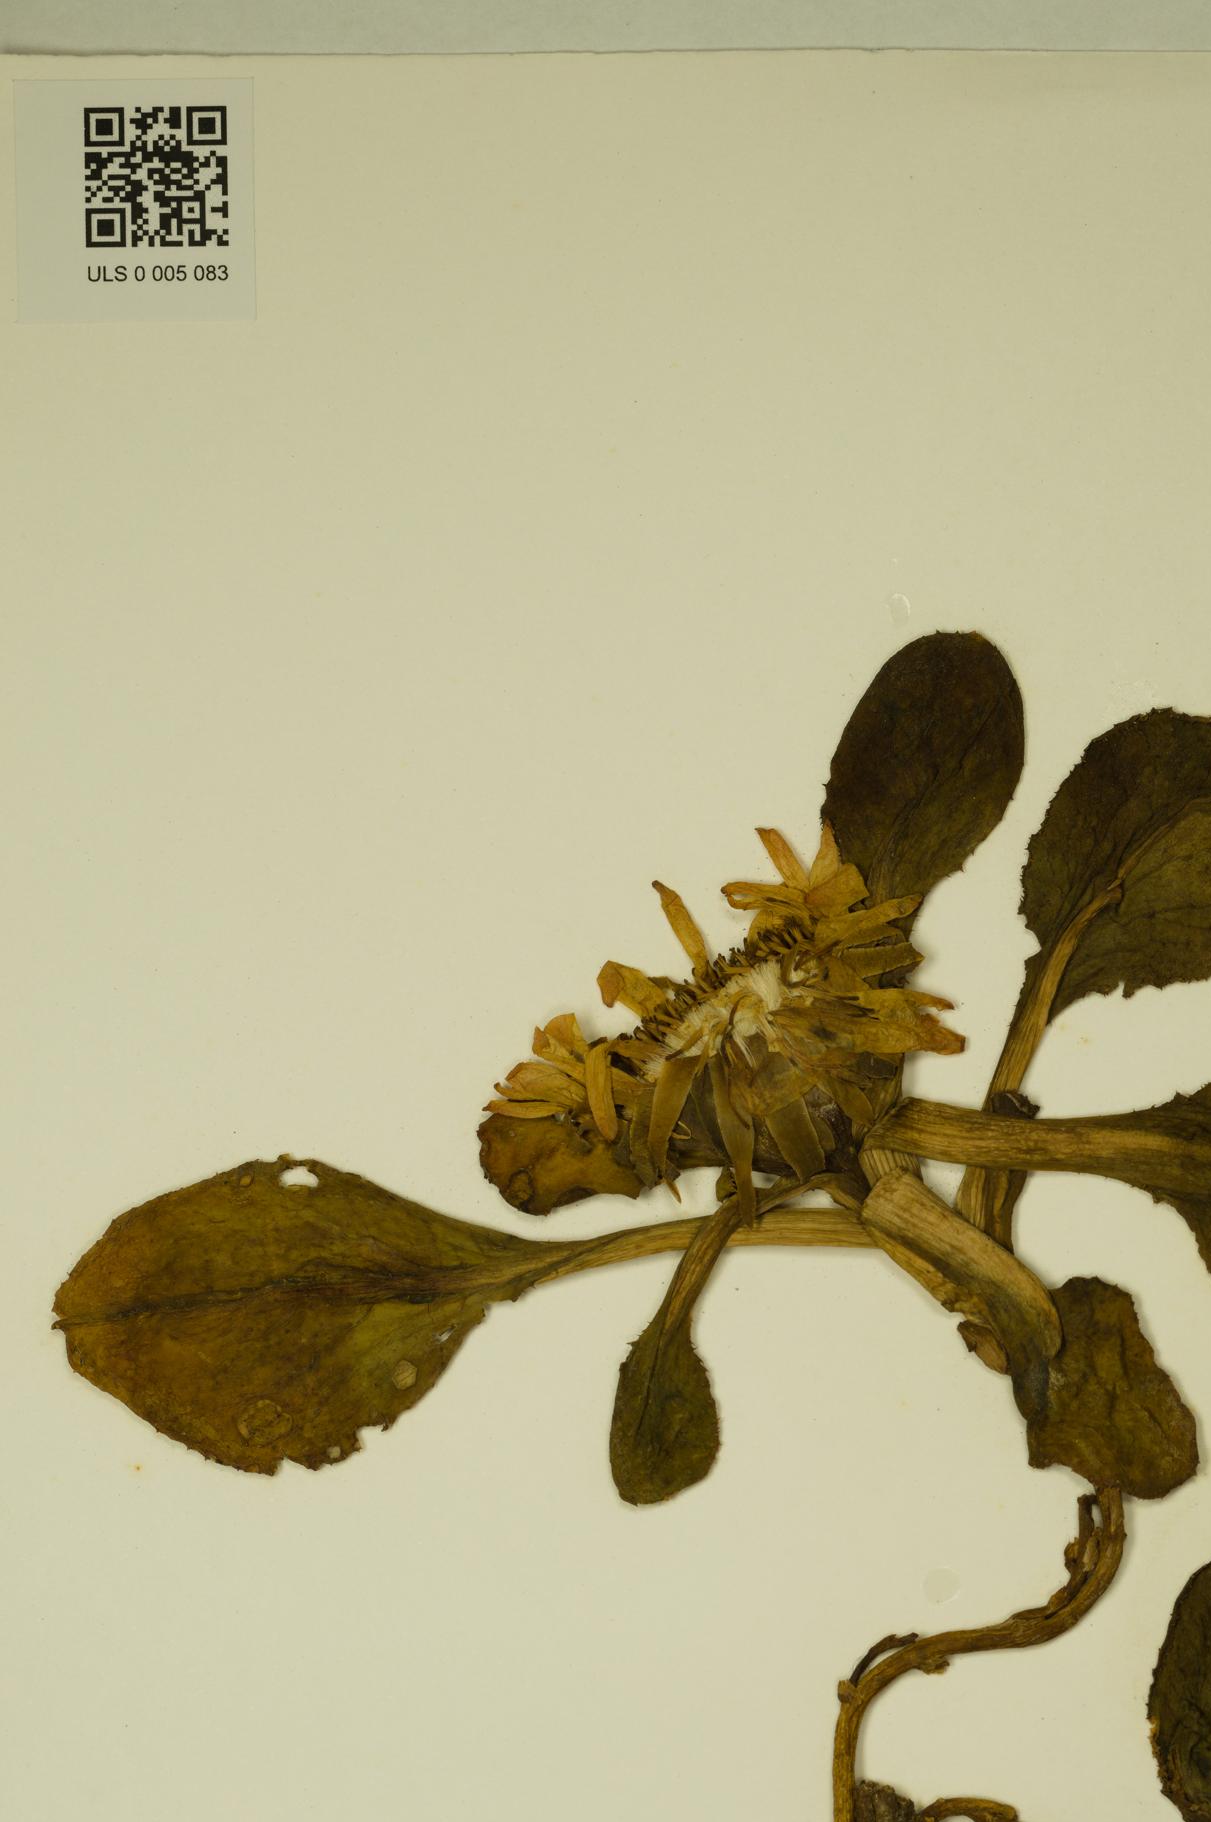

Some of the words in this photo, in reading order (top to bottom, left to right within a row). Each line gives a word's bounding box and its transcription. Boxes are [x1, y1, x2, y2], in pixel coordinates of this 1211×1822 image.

[87, 266, 128, 282] ULS
[134, 265, 145, 281] 0
[152, 265, 187, 281] 005
[194, 265, 229, 281] 083
